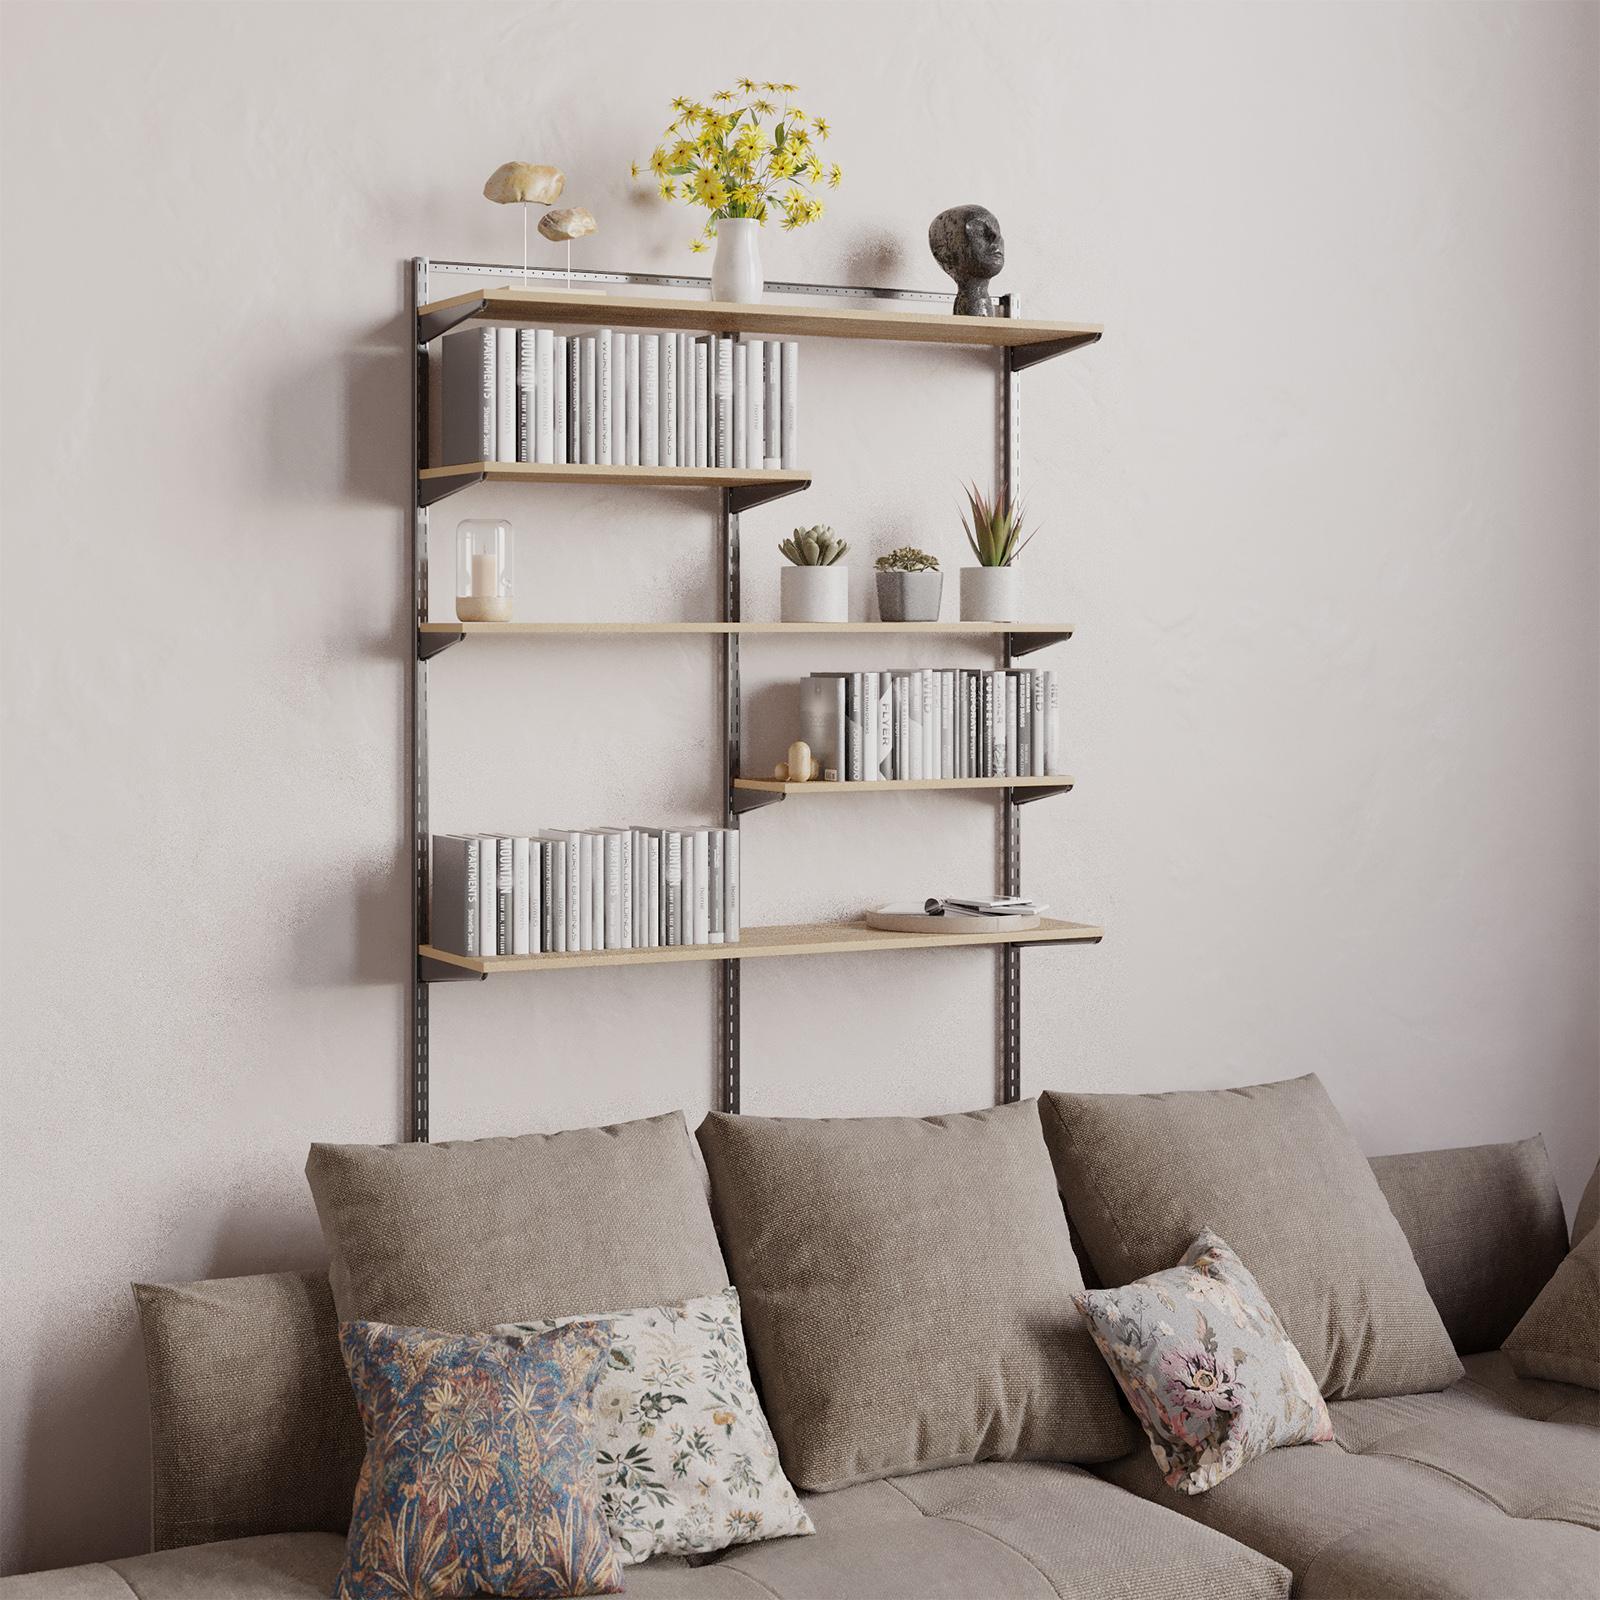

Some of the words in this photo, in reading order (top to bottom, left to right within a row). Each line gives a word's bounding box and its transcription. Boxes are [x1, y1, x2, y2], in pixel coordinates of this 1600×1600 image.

[483, 333, 494, 399] APARTMENTS
[521, 328, 535, 392] MOUNTAIN
[646, 342, 655, 405] APARTMENTS
[719, 339, 732, 400] MOUNTAIN
[468, 845, 477, 902] APARTMENTS
[500, 839, 512, 894] MOUNTAIN
[610, 840, 619, 895] APARTMENTS
[669, 832, 681, 886] MOUNTAIN
